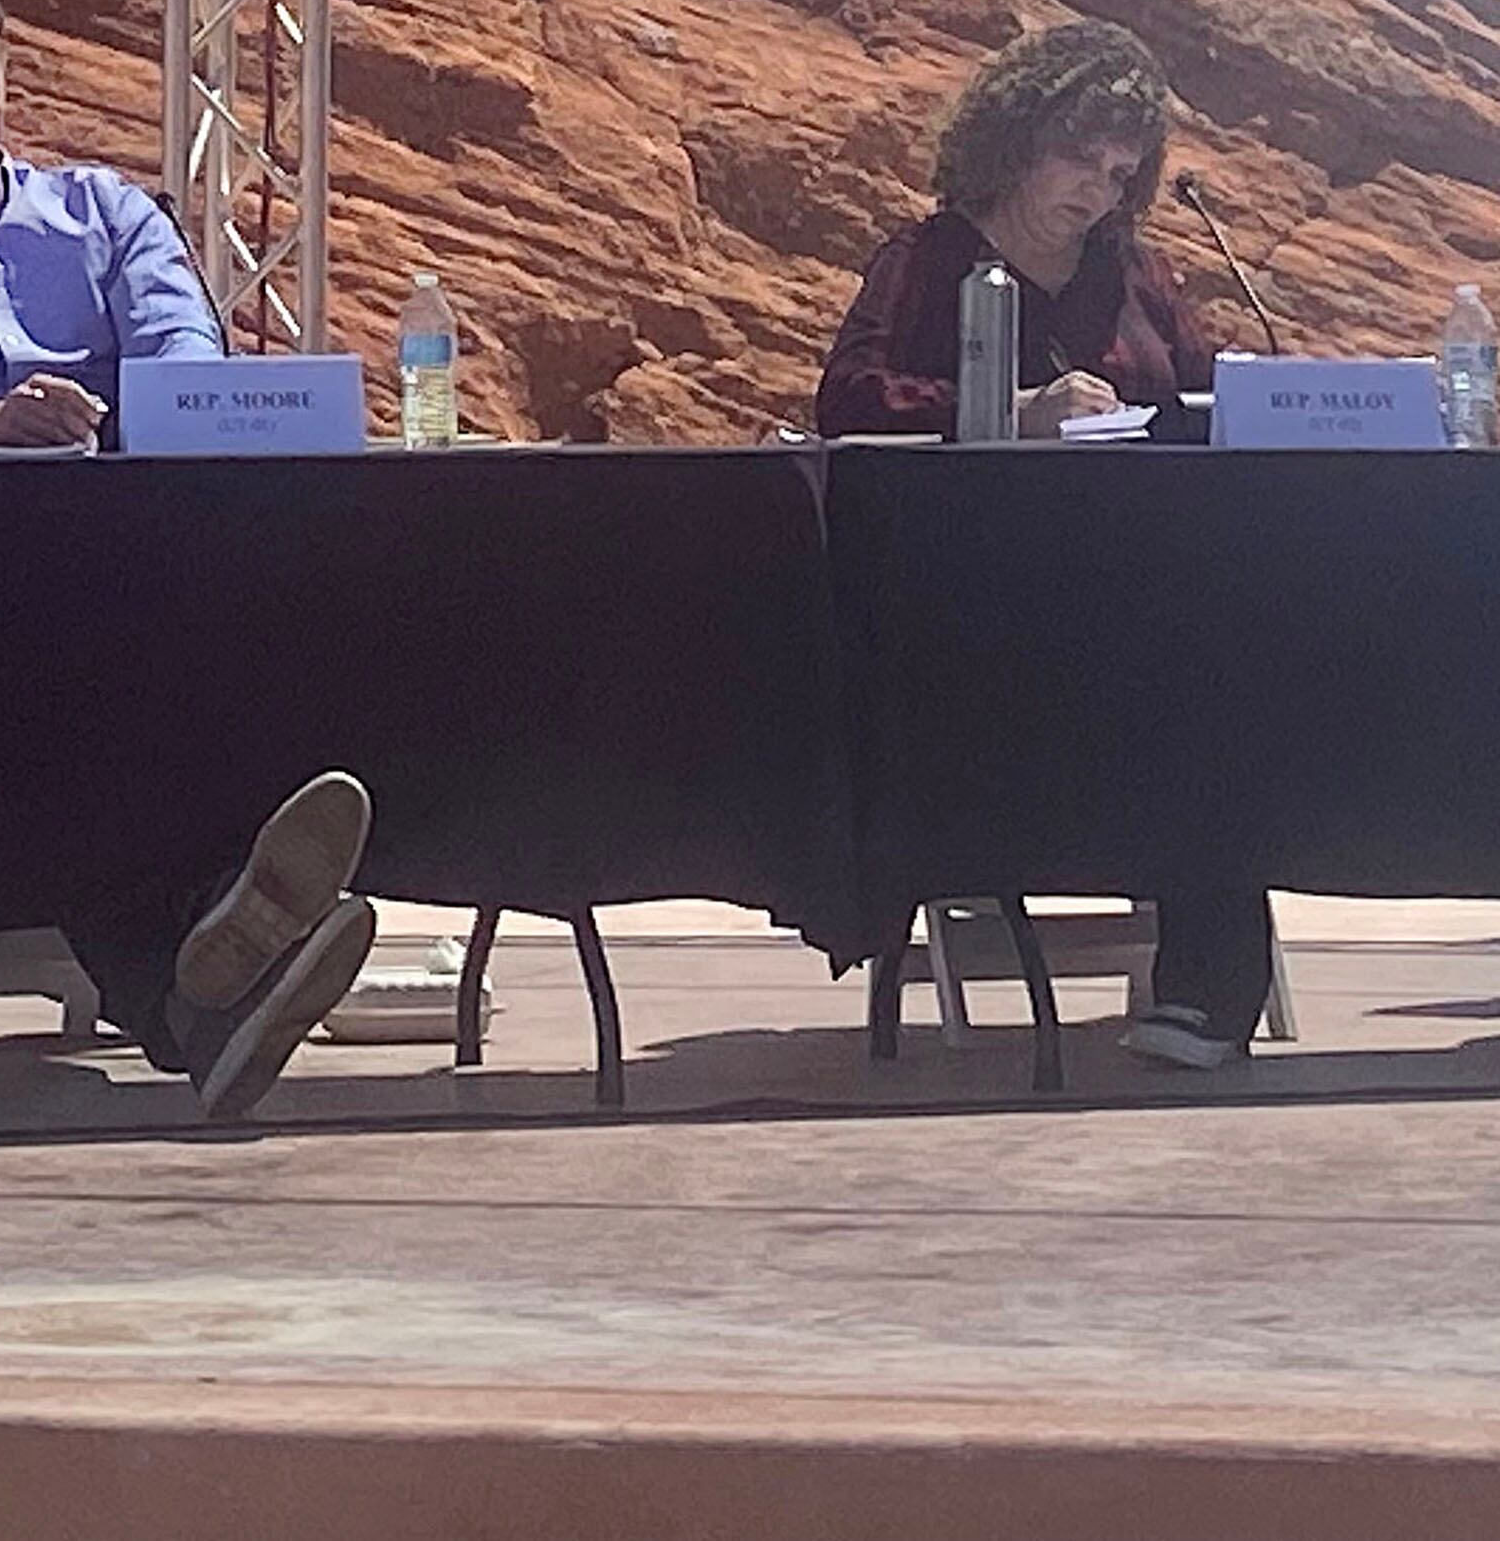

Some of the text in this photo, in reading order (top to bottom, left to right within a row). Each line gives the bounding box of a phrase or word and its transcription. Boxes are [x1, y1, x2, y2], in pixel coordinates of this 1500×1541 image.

[176, 390, 315, 410] REP. MOORE
[1319, 391, 1395, 410] MALOY
